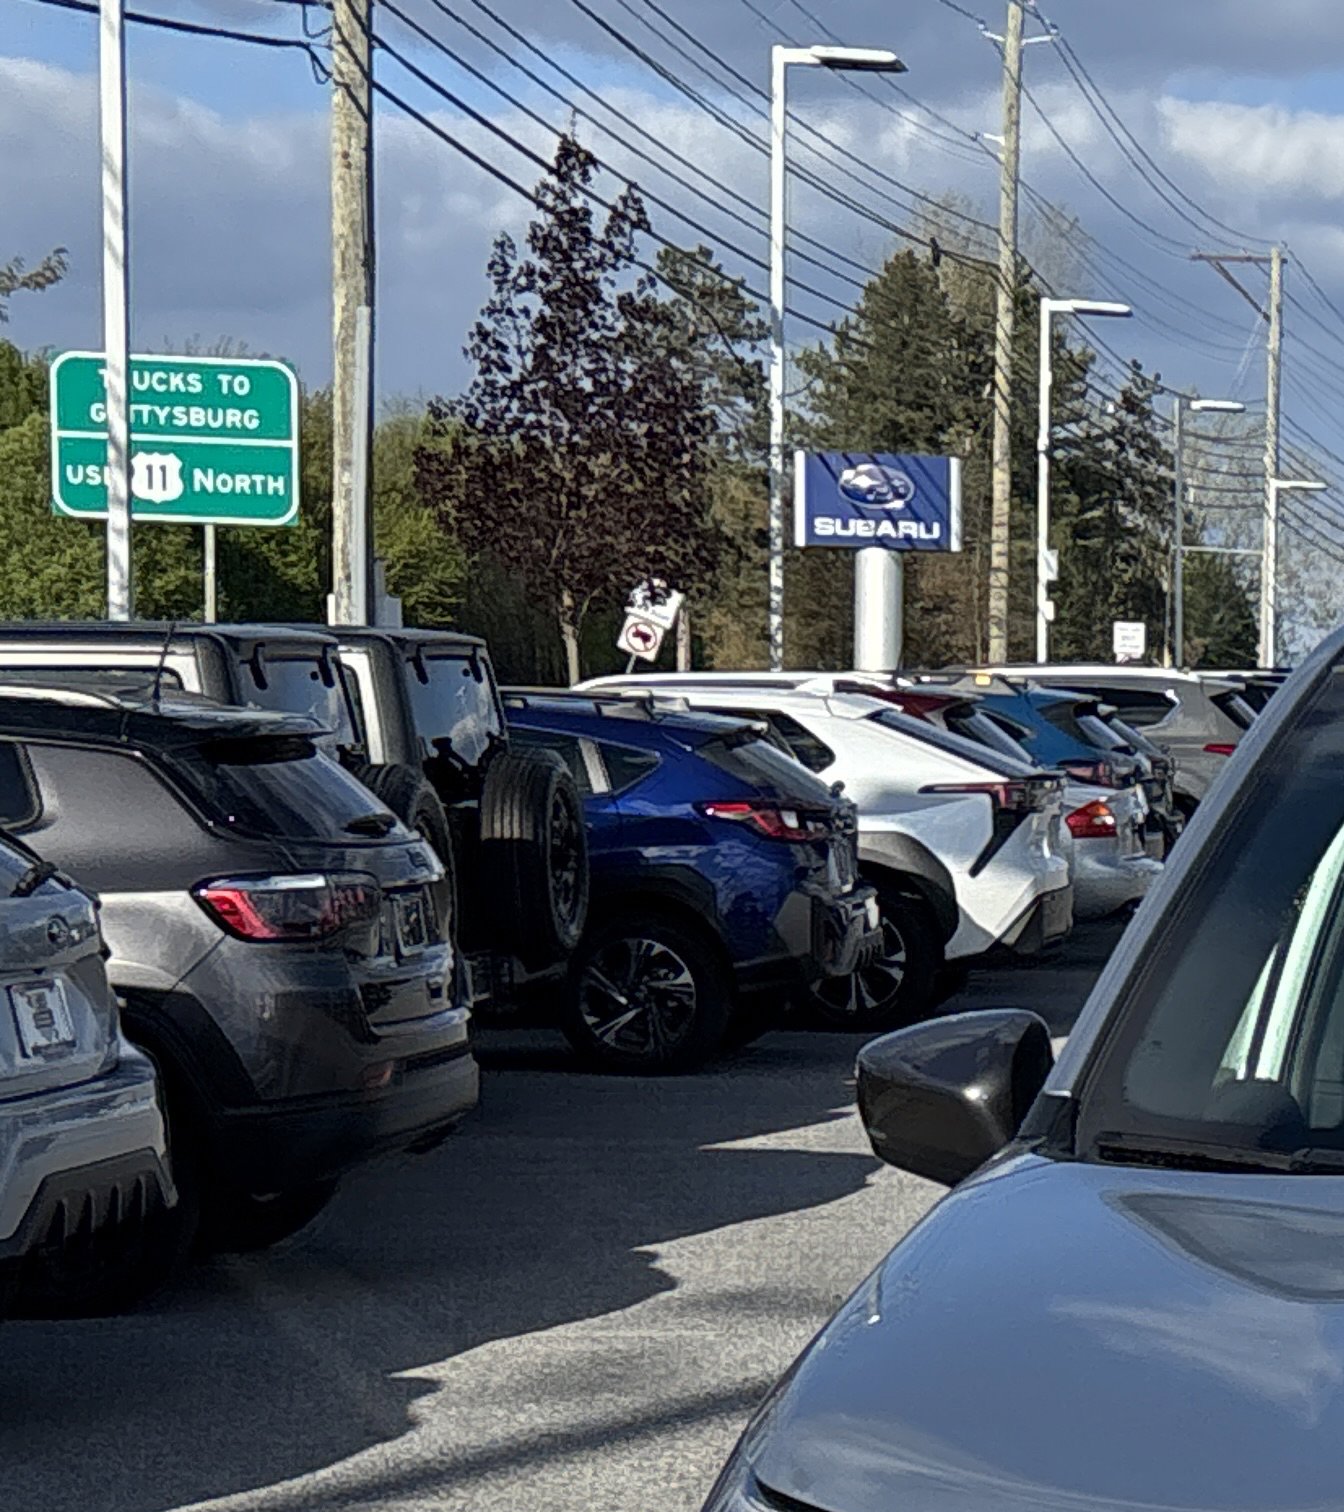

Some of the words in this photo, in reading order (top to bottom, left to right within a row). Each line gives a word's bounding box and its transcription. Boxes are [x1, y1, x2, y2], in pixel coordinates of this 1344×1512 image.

[98, 368, 203, 393] TUCKS
[217, 373, 250, 396] TO
[90, 402, 261, 430] GTTYSBURG
[66, 464, 109, 488] US
[145, 464, 168, 491] 11
[192, 467, 285, 496] NORTH
[814, 516, 941, 539] SUBARU
